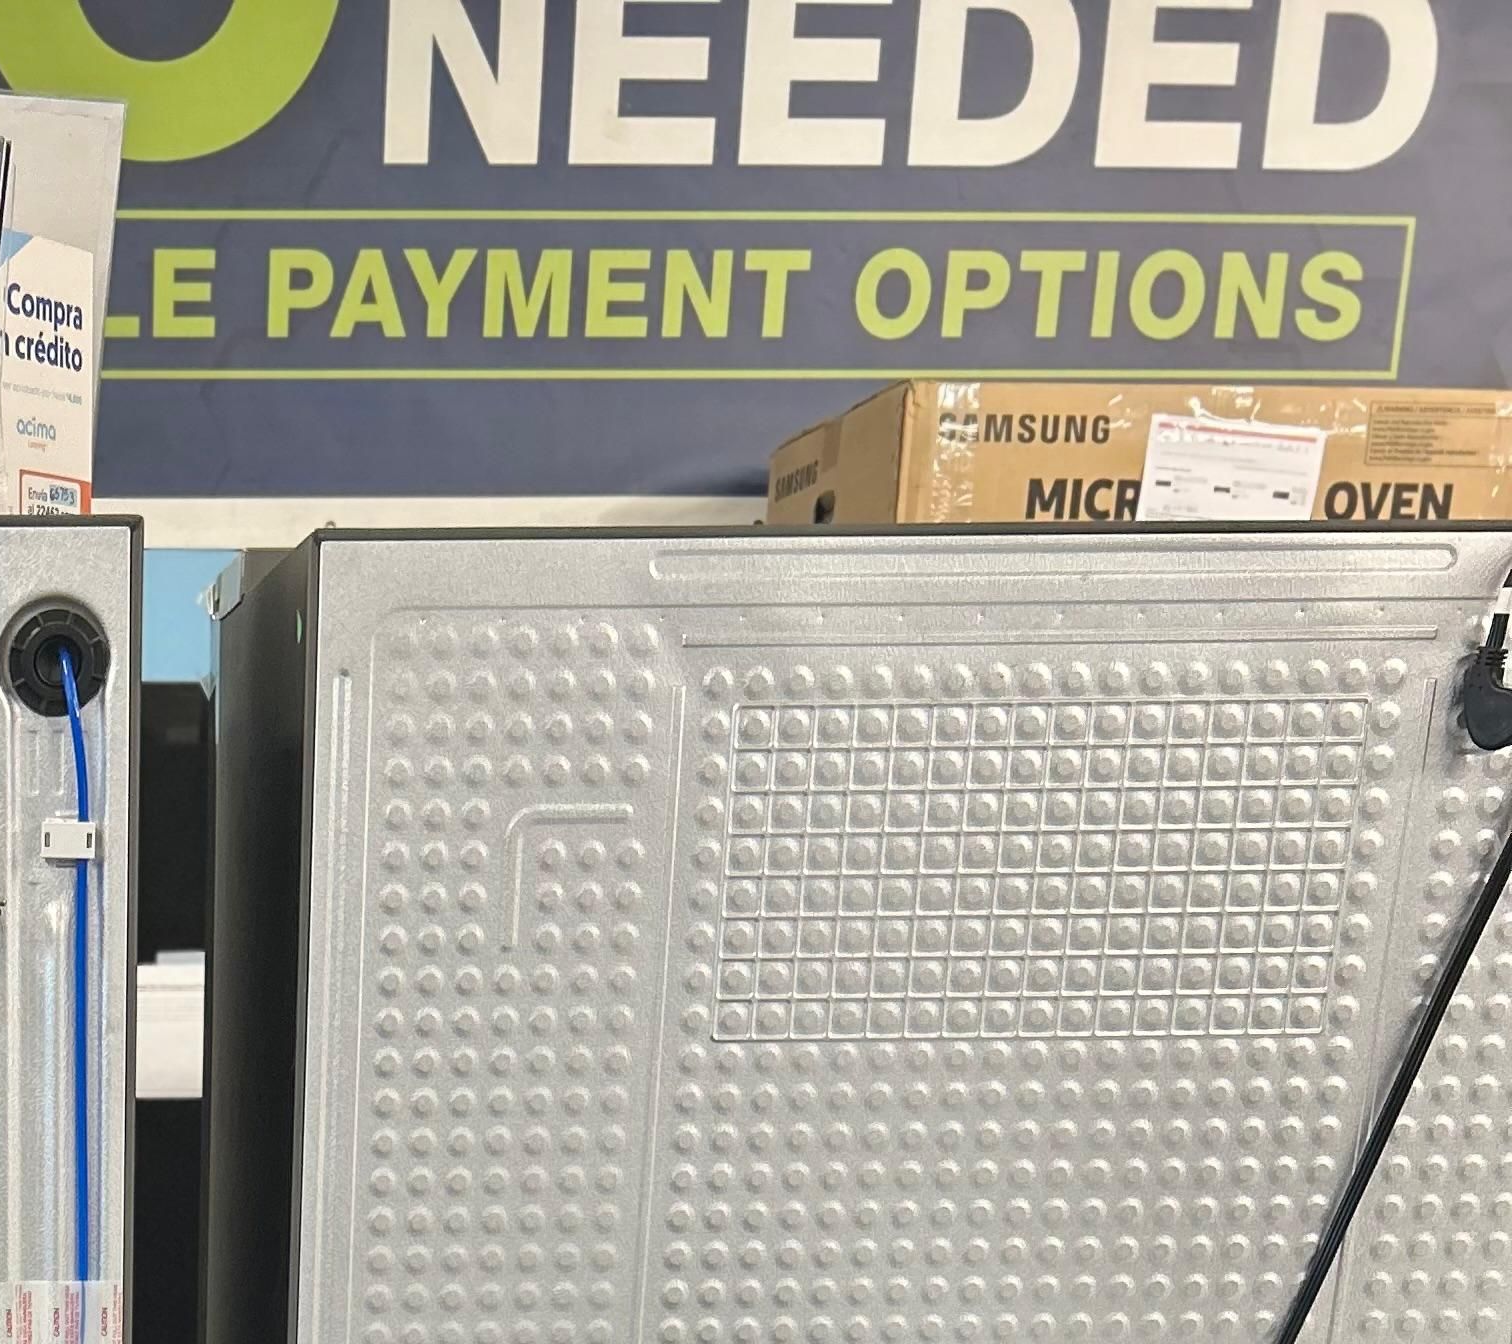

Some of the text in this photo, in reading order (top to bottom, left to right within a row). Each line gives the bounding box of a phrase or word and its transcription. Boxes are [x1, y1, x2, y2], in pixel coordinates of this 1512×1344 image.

[382, 0, 1439, 171] NEEDED
[7, 282, 83, 332] Compra
[268, 248, 811, 340] PAYMENT
[854, 247, 1365, 342] OPTIONS
[15, 331, 83, 372] crédito
[16, 416, 57, 441] acima
[938, 412, 1111, 444] SAMSUNG
[1323, 481, 1454, 521] OVEN
